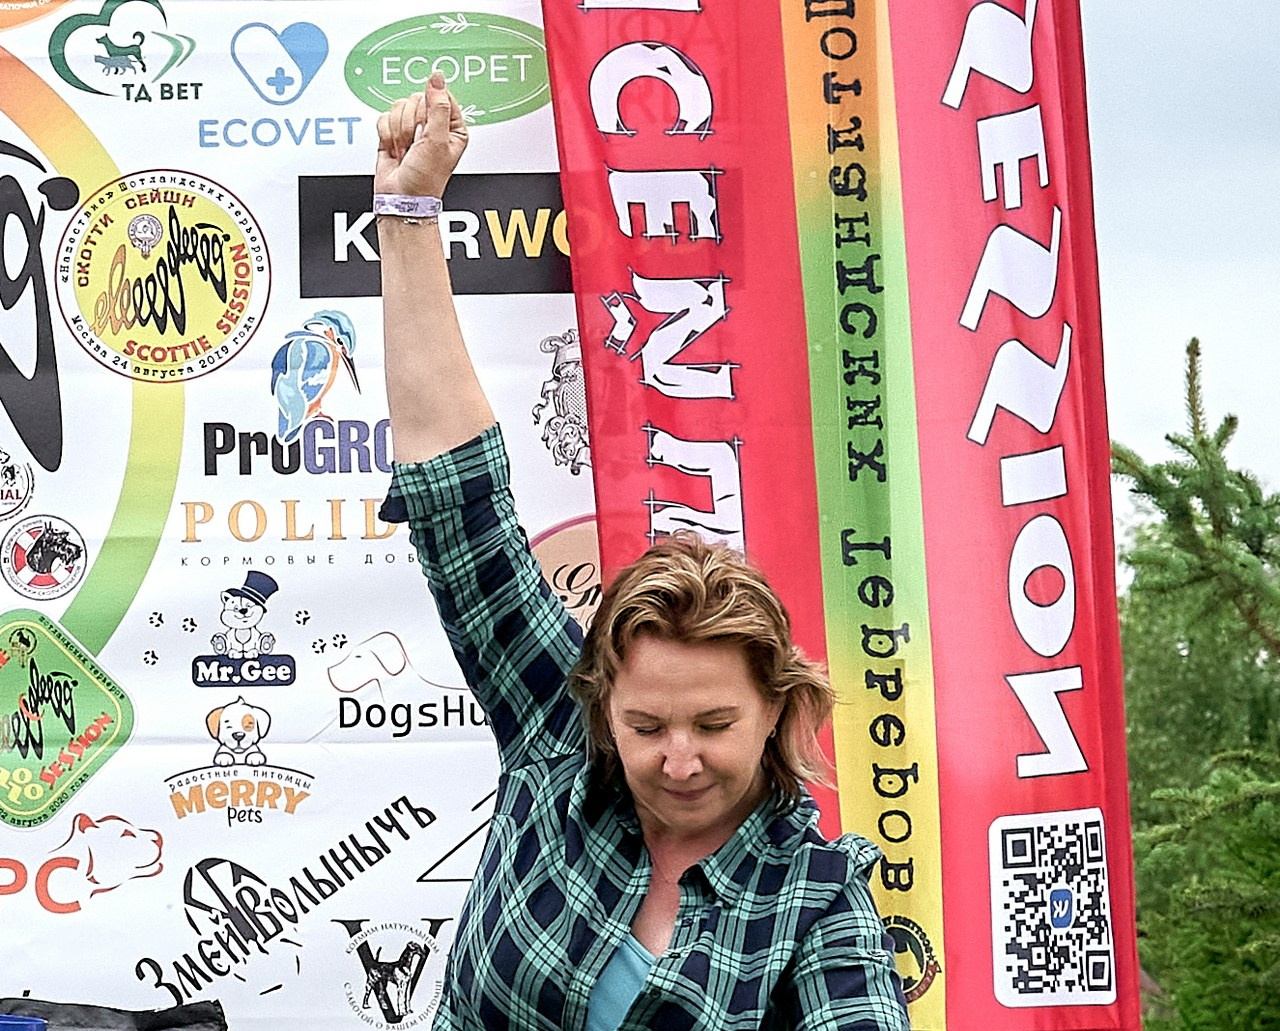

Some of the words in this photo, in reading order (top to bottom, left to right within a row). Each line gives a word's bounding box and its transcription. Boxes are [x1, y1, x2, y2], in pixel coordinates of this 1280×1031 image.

[122, 83, 152, 102] ТД
[161, 83, 203, 100] ВЕТ
[199, 117, 362, 148] ECOVET
[123, 335, 213, 363] SCOTTIE
[216, 243, 251, 336] SESSION
[181, 553, 335, 566] КОРМОВЫЕ
[227, 807, 263, 827] pets
